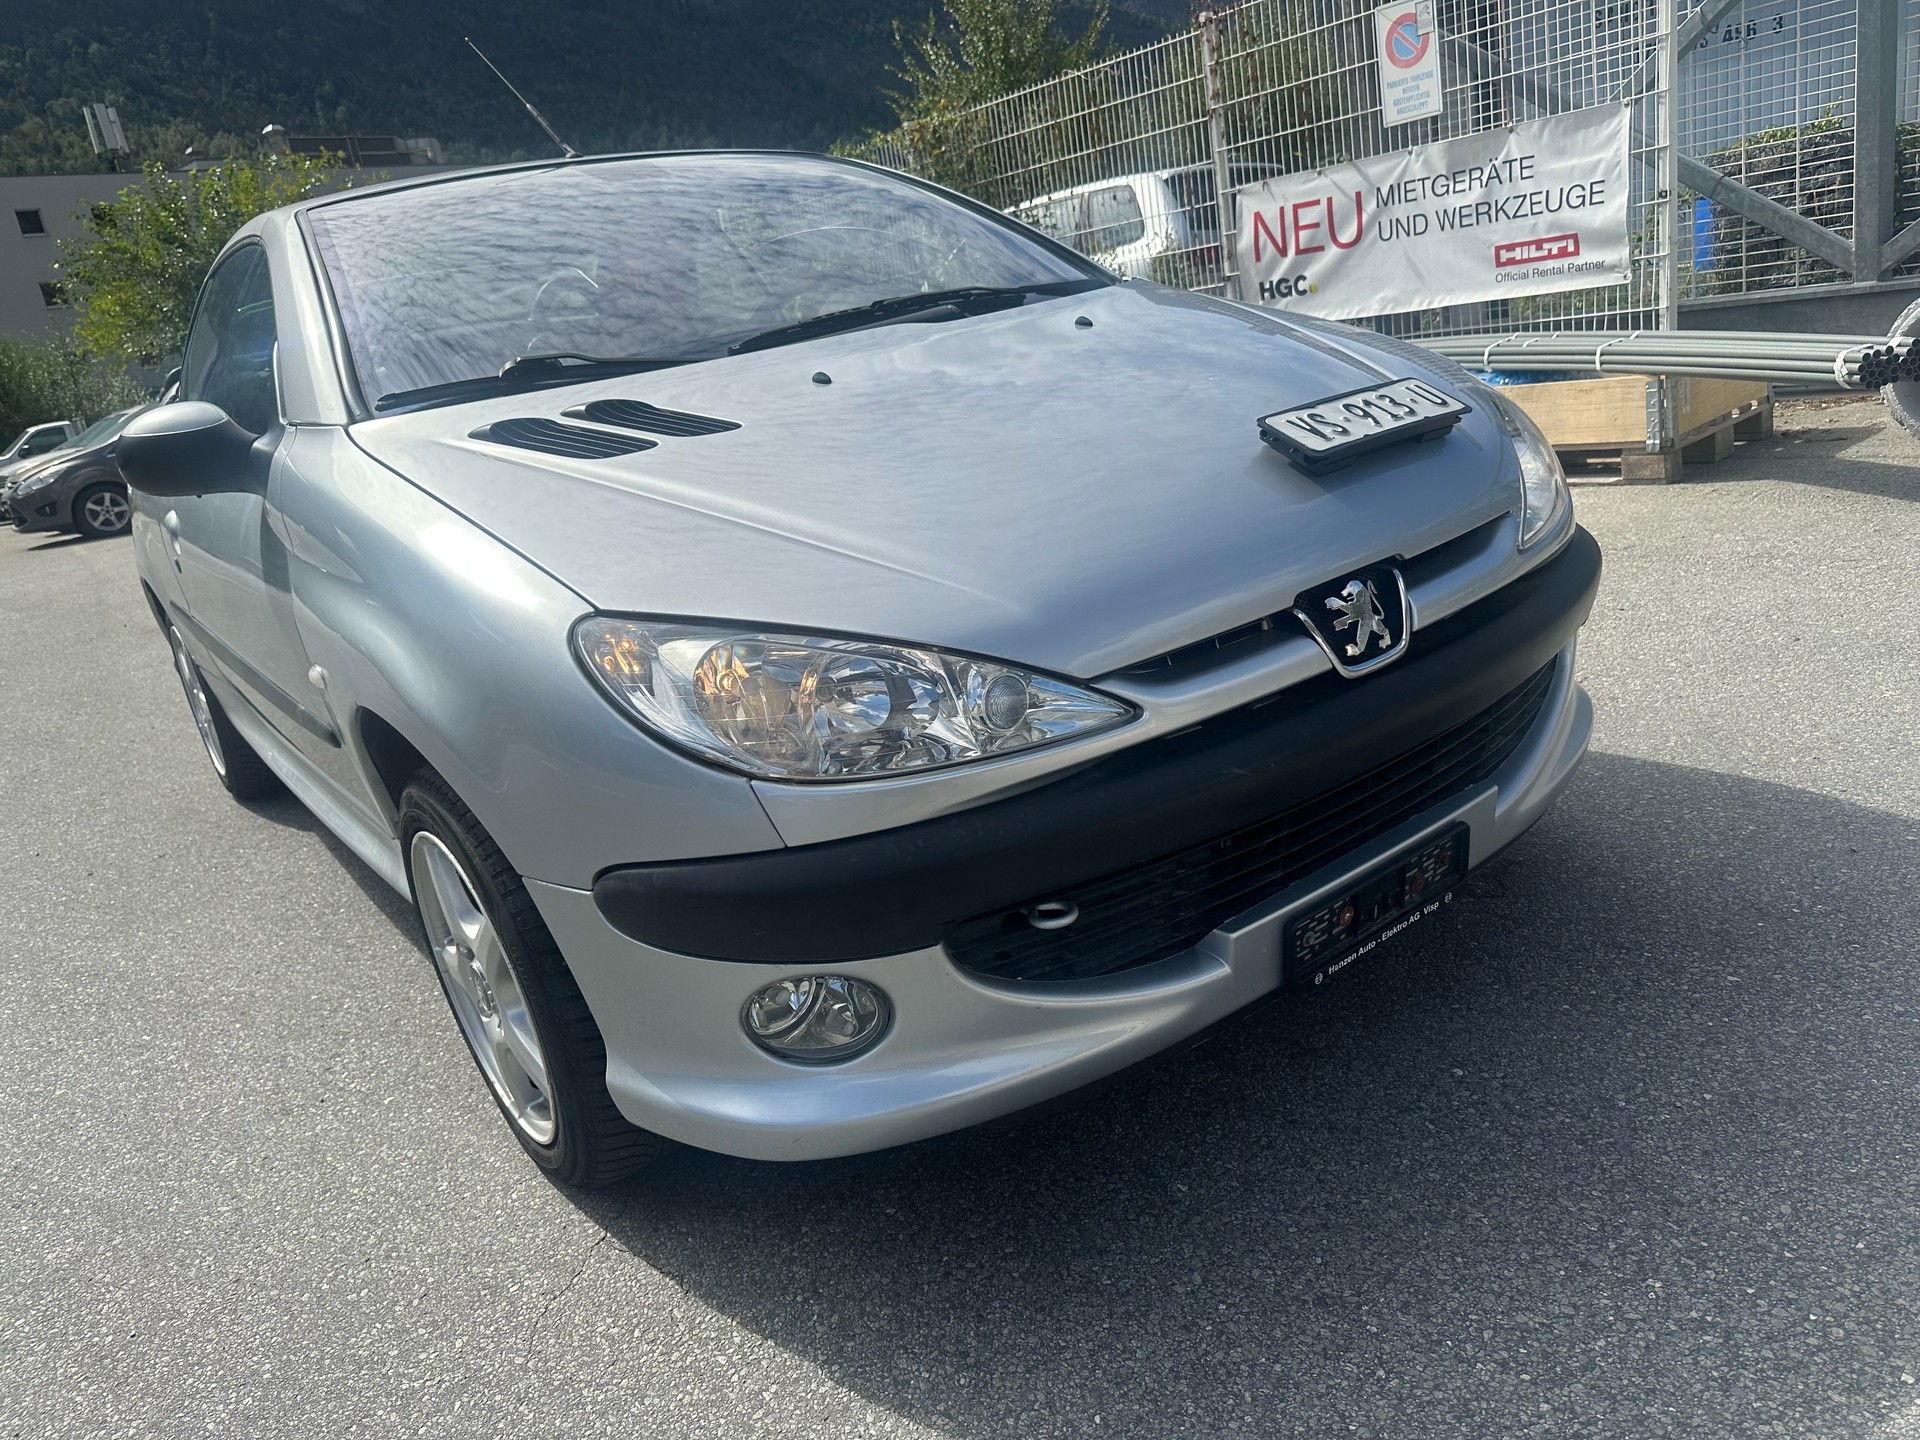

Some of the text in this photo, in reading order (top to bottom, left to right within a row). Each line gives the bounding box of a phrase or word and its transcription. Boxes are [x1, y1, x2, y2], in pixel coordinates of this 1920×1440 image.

[1375, 155, 1535, 208] MIETGERÄTE
[1253, 188, 1363, 263] NEU
[1378, 180, 1606, 242] UND WERKZEUGE
[1495, 259, 1606, 284] Official Rental Partner
[1499, 237, 1575, 263] HILTI
[1357, 941, 1376, 957] Auto
[1381, 921, 1407, 941] Elektro
[1408, 911, 1420, 925] AG
[1423, 901, 1439, 915] Visp
